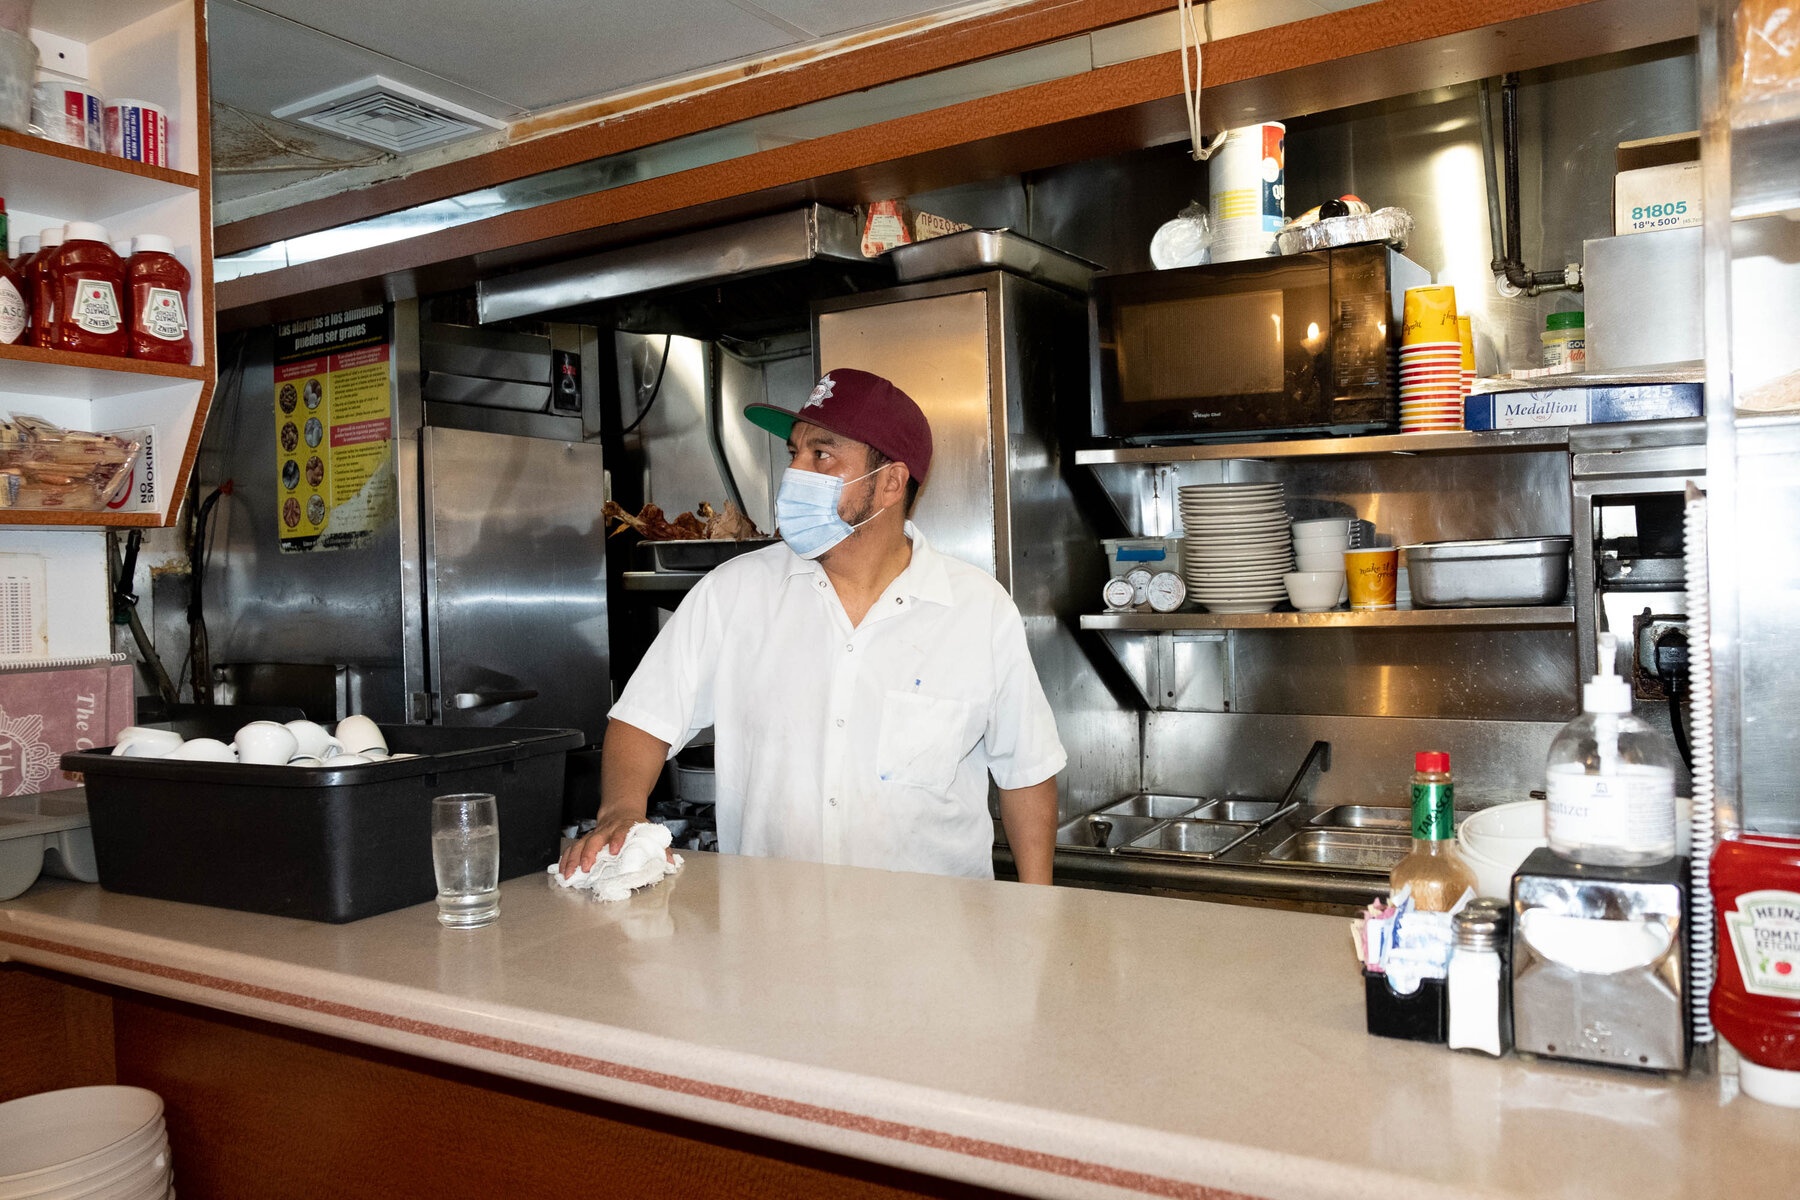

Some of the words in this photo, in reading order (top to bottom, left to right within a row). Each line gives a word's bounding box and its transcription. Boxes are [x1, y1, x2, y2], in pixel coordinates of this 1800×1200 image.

[1632, 201, 1686, 220] 81805
[1658, 217, 1680, 226] 500'
[86, 308, 110, 316] TOMATO
[292, 317, 324, 334] alergias
[325, 316, 330, 326] a
[331, 312, 342, 325] los
[344, 304, 384, 322] alimentos
[88, 318, 110, 326] HEINZ
[158, 325, 178, 334] HEINZ
[295, 332, 324, 351] pueden
[325, 330, 338, 343] ser
[340, 324, 366, 342] graves
[1504, 402, 1577, 416] Medallion
[141, 483, 146, 503] NO
[76, 693, 95, 731] The
